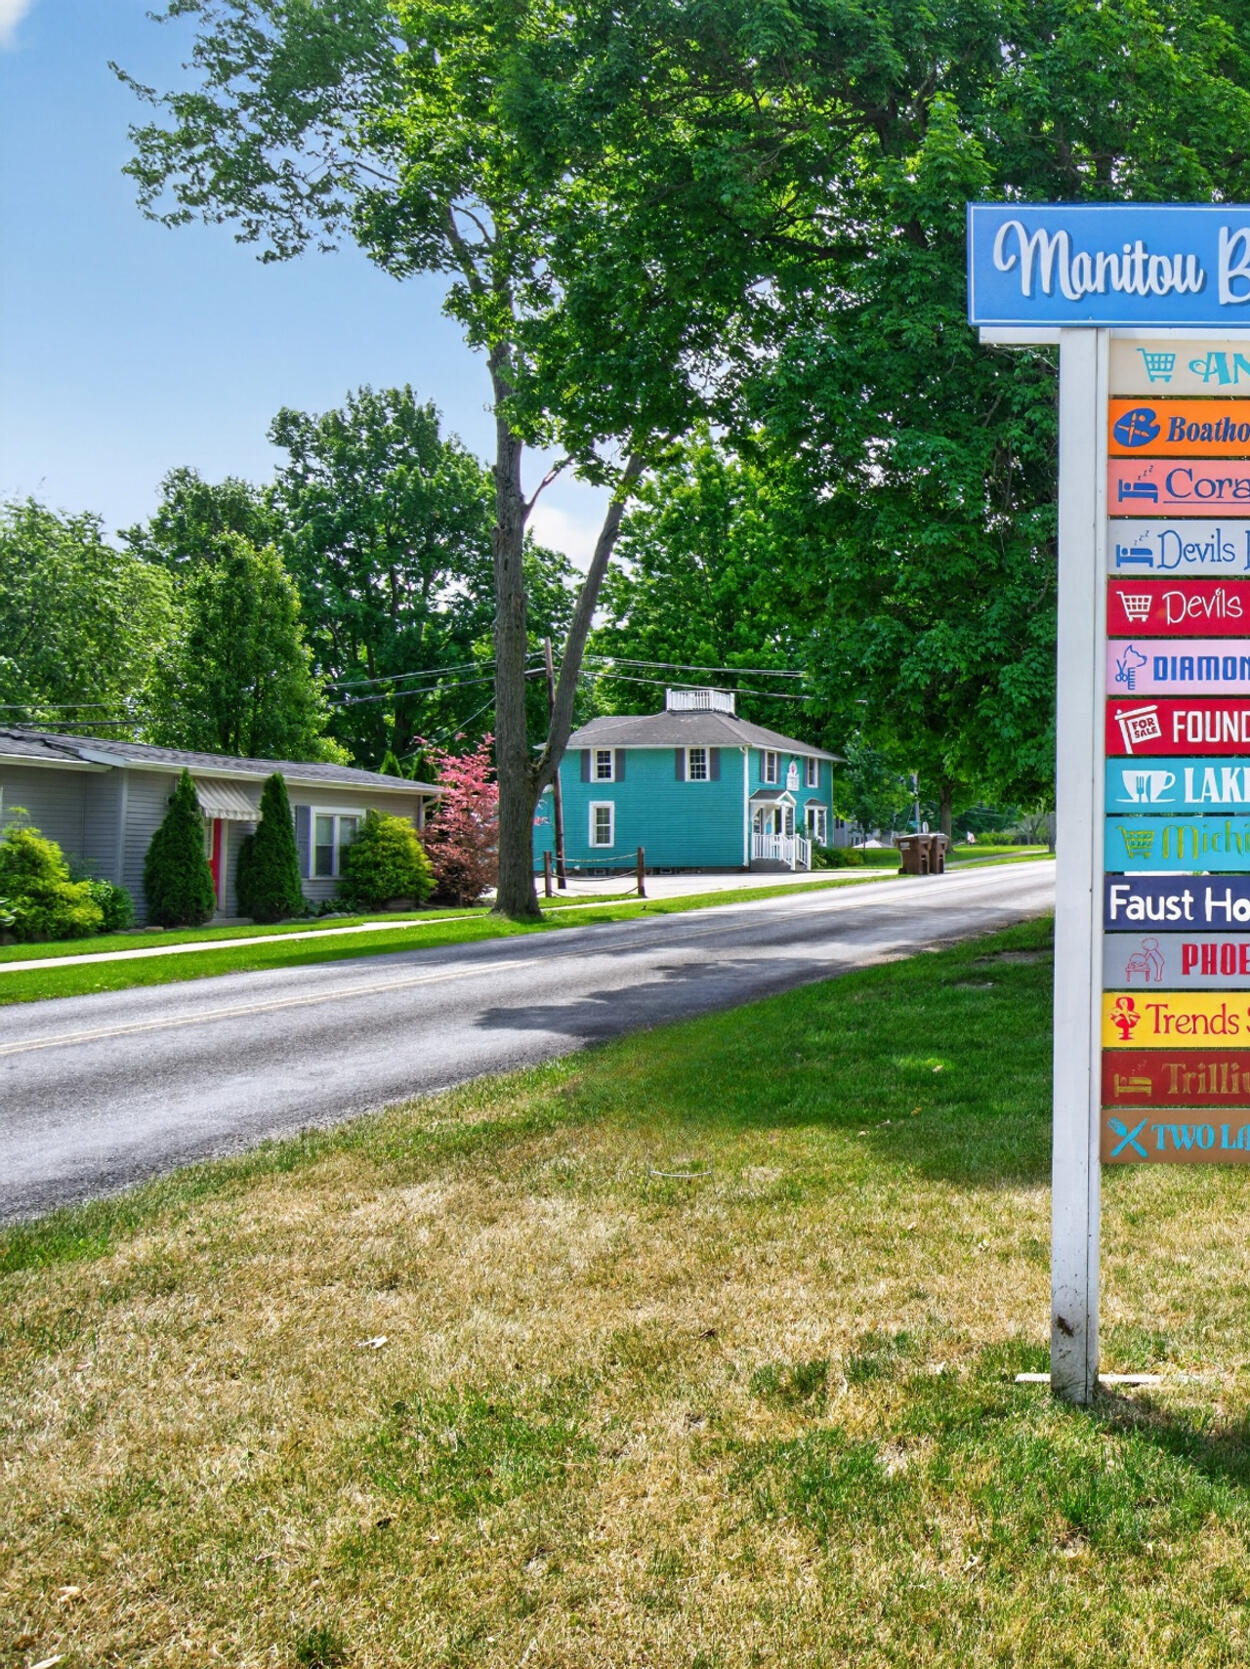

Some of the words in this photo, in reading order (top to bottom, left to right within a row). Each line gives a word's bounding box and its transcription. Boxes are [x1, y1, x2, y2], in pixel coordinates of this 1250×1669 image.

[993, 219, 1204, 300] Manitou
[1157, 528, 1236, 569] Devils
[1162, 587, 1244, 625] Devils
[1132, 717, 1155, 730] FOR
[1134, 726, 1158, 738] SALE
[1109, 884, 1194, 920] Faust
[1145, 1002, 1240, 1035] Trends
[1151, 1124, 1215, 1150] TWO
